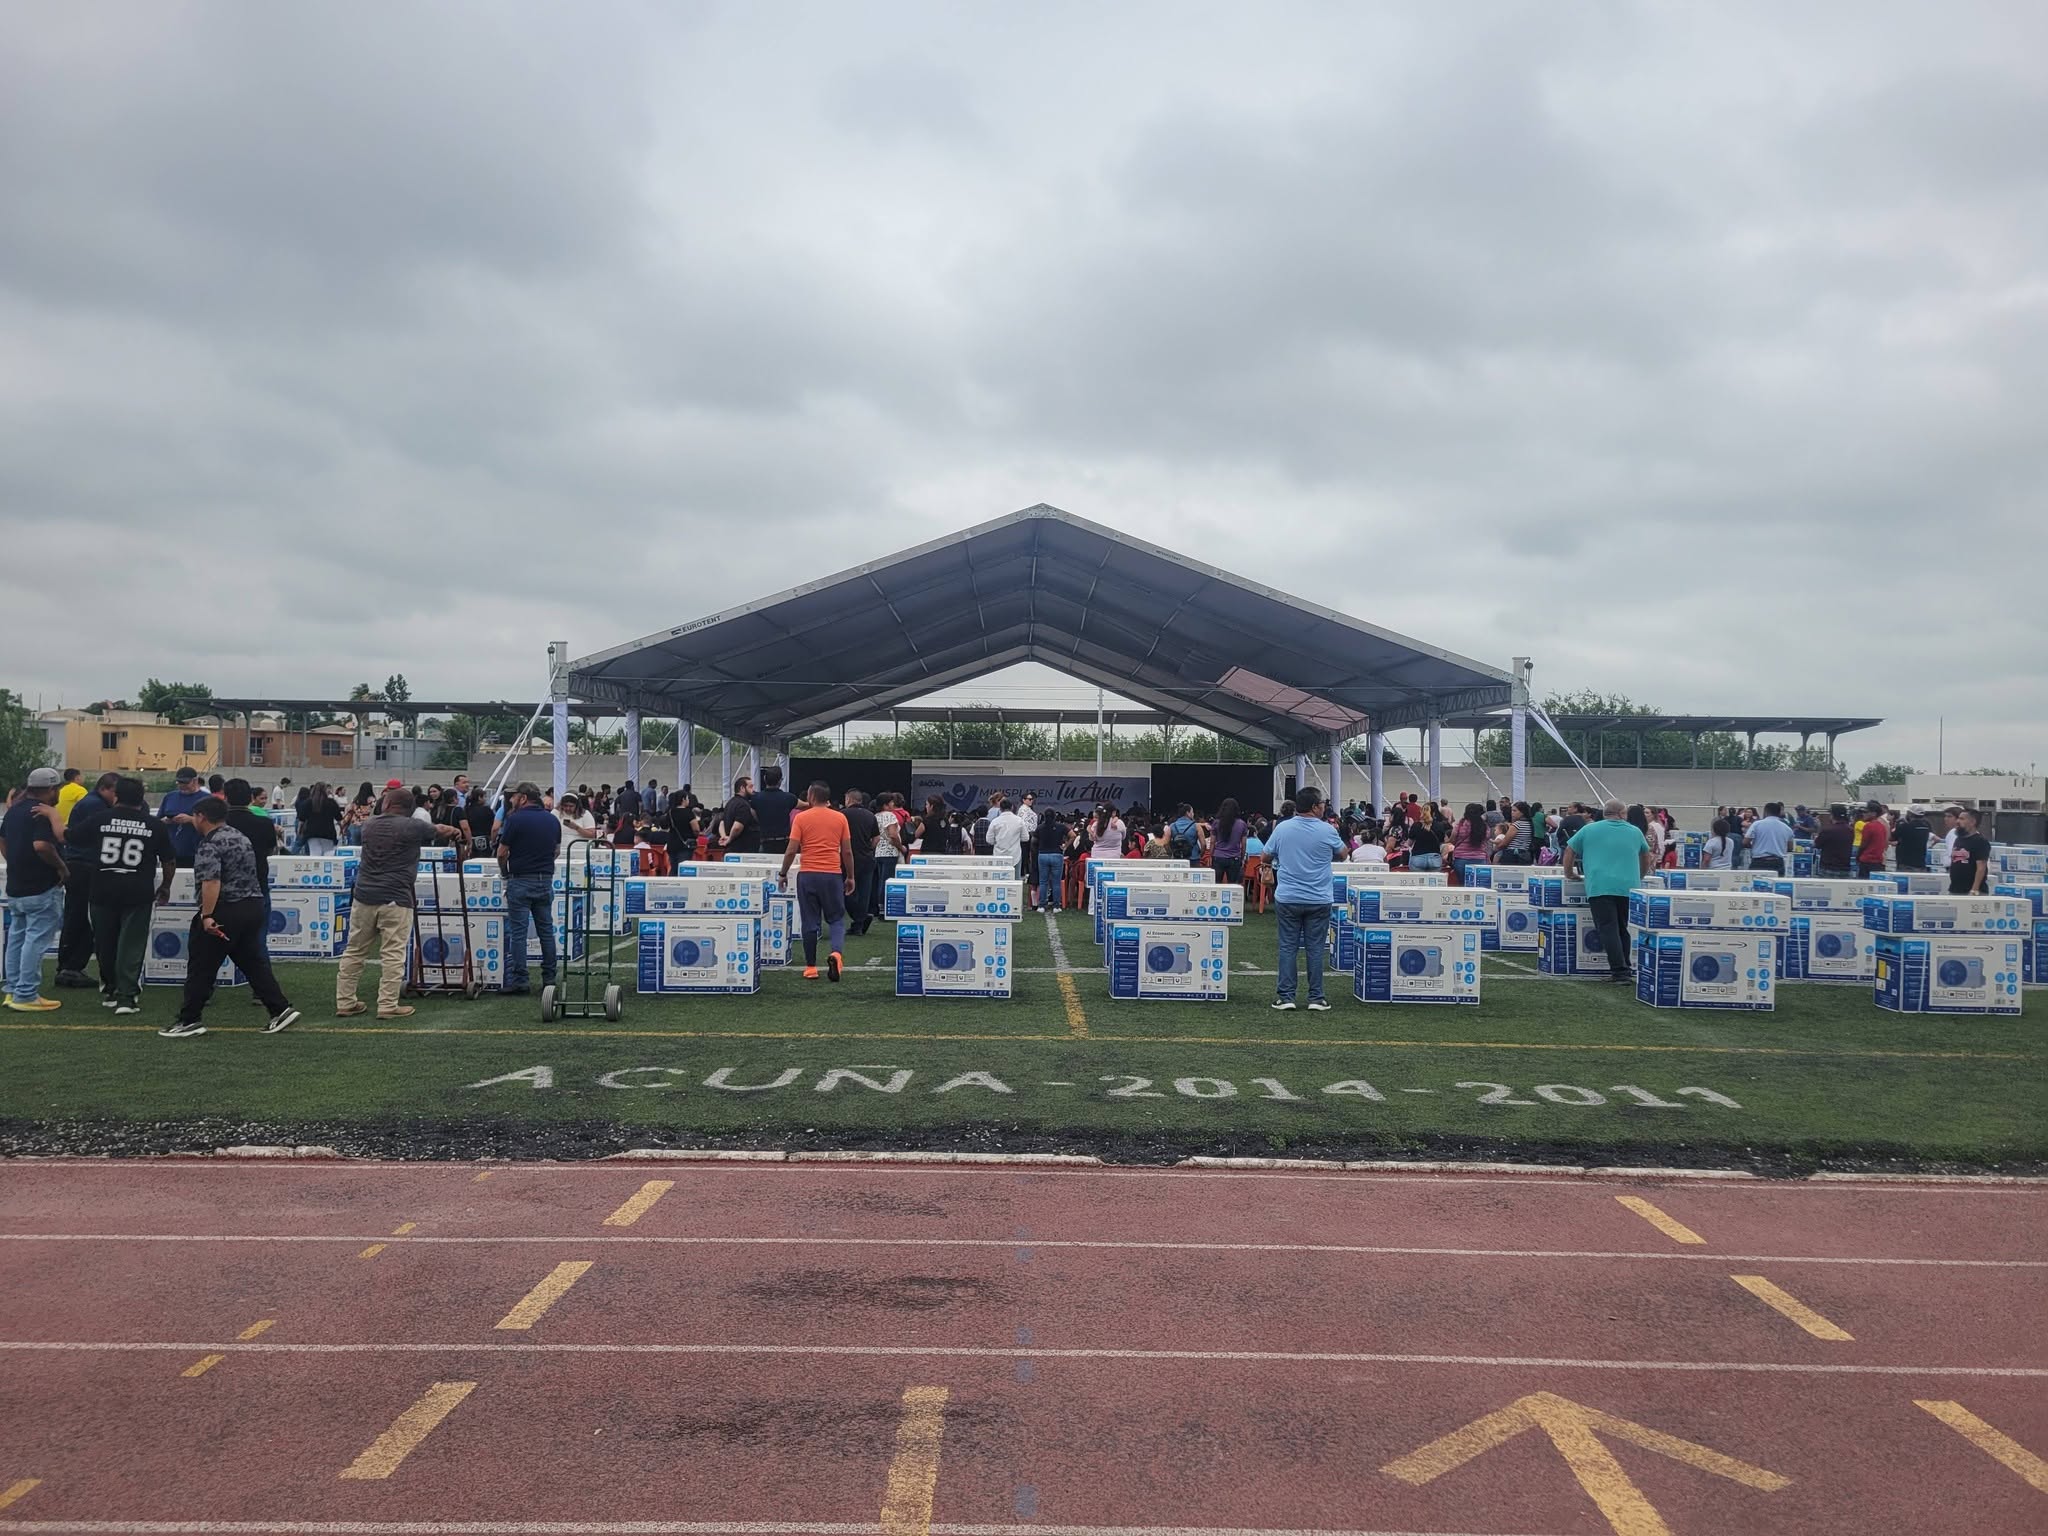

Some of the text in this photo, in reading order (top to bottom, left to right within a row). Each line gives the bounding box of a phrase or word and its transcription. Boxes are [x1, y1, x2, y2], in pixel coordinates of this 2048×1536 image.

[681, 615, 721, 632] EUROTENT
[1055, 779, 1077, 801] Tu
[1080, 780, 1125, 802] Aula
[111, 818, 146, 829] ESCUELA
[100, 836, 145, 867] 56
[1116, 928, 1138, 937] Midea
[1099, 1075, 1387, 1101] 2014
